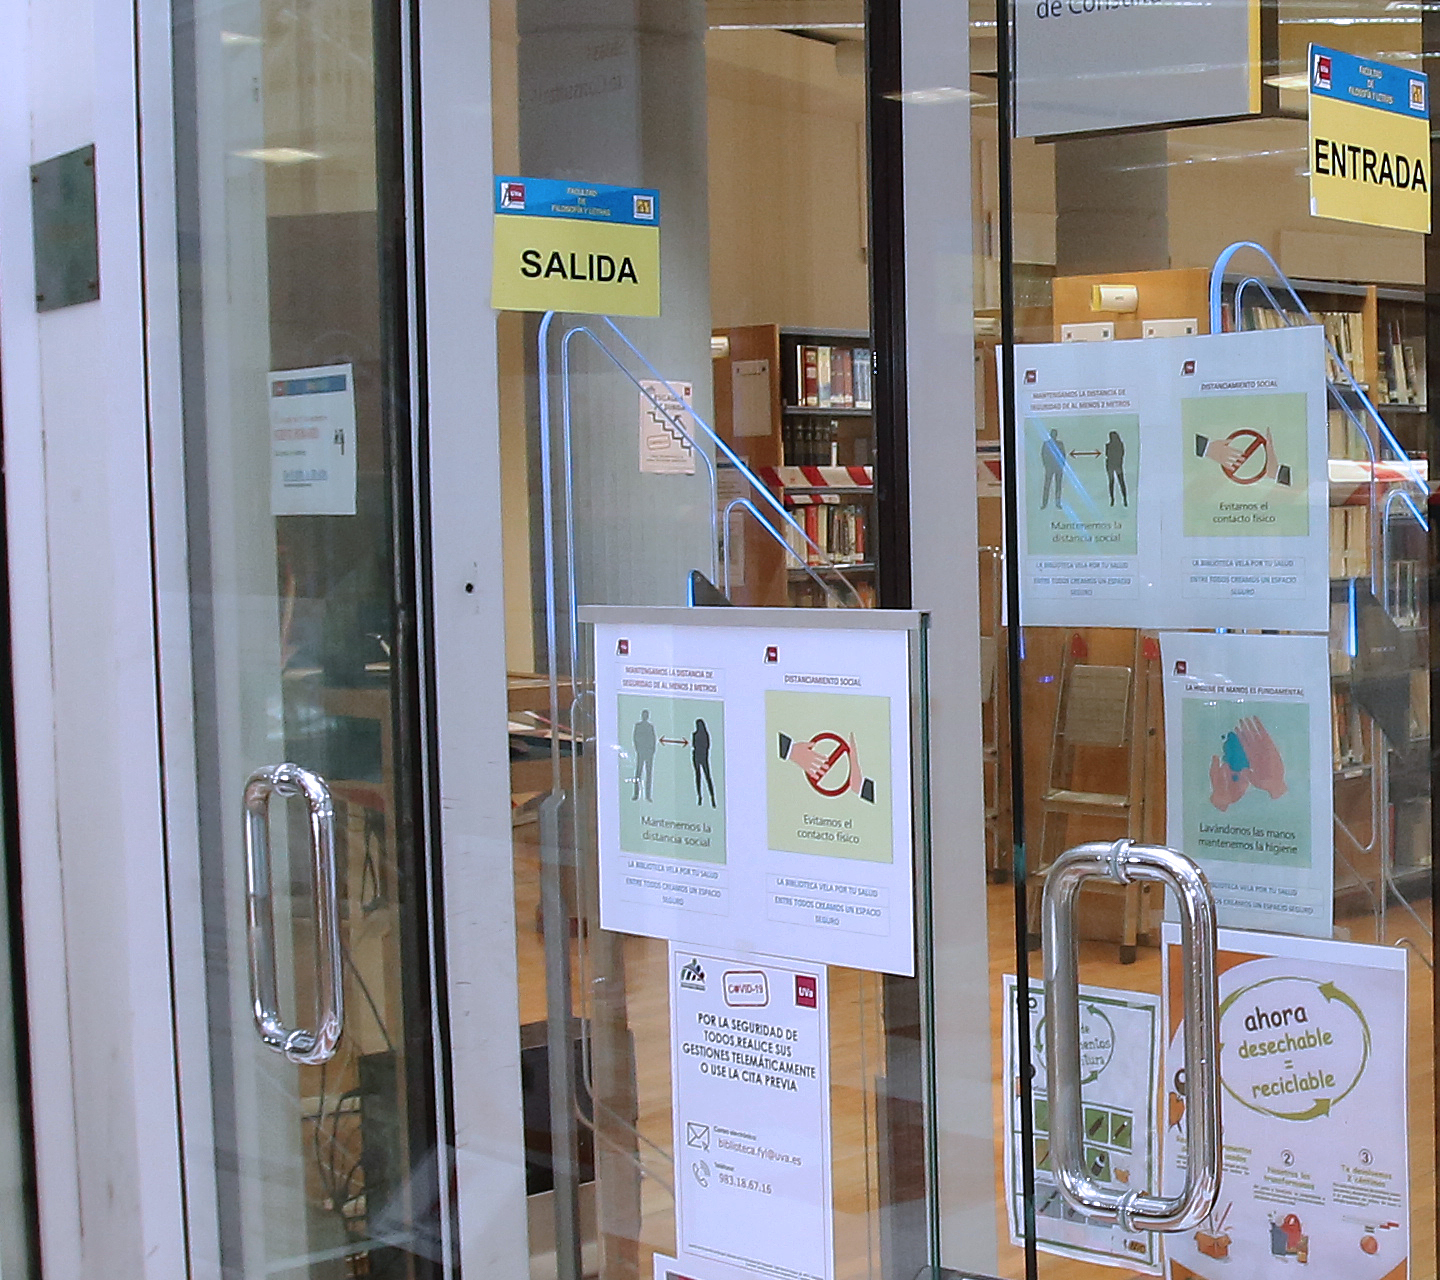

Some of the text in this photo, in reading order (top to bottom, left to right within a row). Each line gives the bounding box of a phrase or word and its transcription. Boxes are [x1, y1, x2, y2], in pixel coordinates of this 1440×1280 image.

[1315, 138, 1428, 193] ENTRADA
[520, 249, 639, 284] SALIDA
[797, 829, 835, 841] contacto
[803, 814, 842, 828] Evitamos
[1252, 826, 1265, 838] las
[1266, 830, 1296, 840] manos
[698, 1012, 798, 1041] POR LA SEGURIDAD DE
[1244, 1005, 1309, 1032] ahora
[774, 1043, 792, 1058] SUS
[1238, 1026, 1334, 1059] desechable
[682, 1042, 817, 1079] GESTIONES TELEMÁTICAMENTE
[699, 1062, 798, 1092] O USE LA CITA PREVIA
[1252, 1069, 1336, 1099] reciclable
